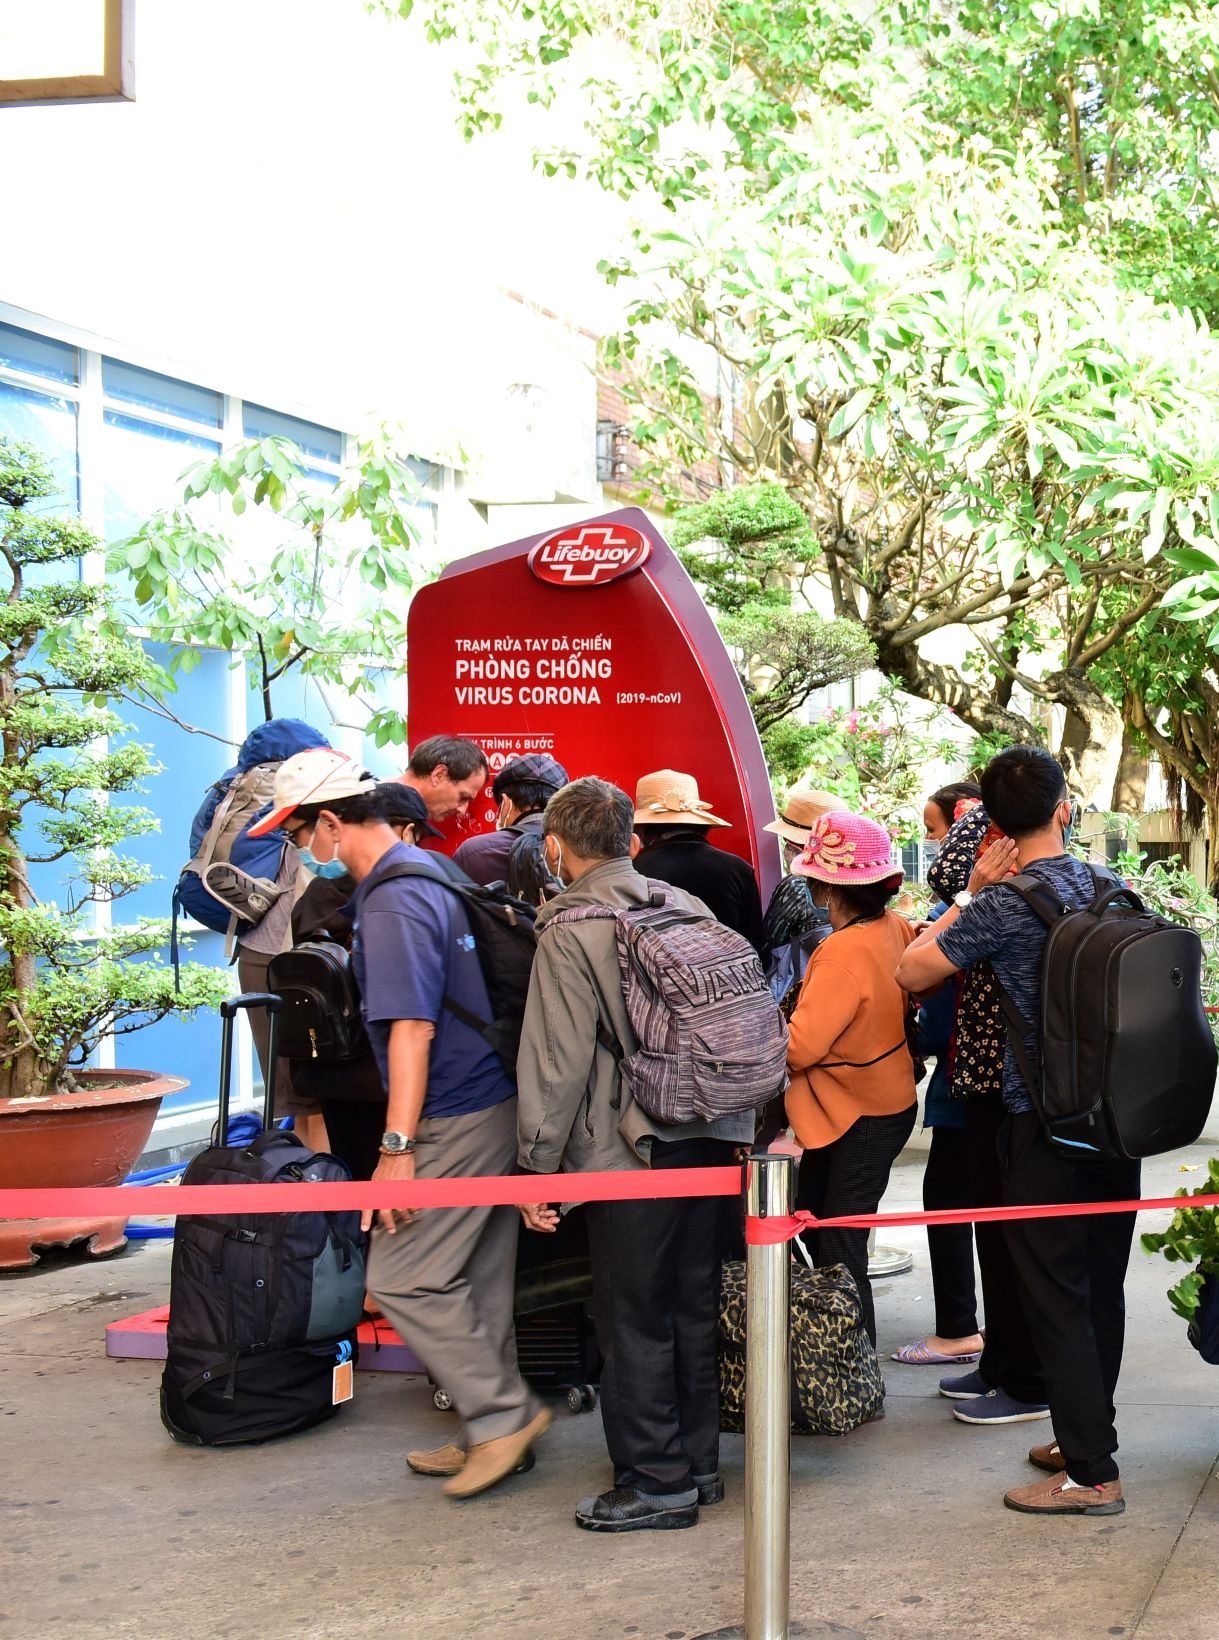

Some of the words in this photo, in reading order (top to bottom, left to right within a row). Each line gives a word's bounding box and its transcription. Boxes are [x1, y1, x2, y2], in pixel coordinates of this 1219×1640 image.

[541, 545, 637, 564] Lifebuoy
[455, 639, 490, 654] TRẠM
[496, 636, 521, 651] RỬA
[525, 639, 548, 650] TAY
[572, 633, 611, 650] CHIẾN
[455, 655, 530, 679] PHÒNG
[536, 653, 611, 679] CHỐNG
[455, 687, 513, 704] VIRUS
[518, 687, 601, 704] CORONA
[616, 693, 681, 704] (2019-nCoV)
[481, 737, 512, 749] TRÌNH
[515, 739, 521, 749] 6
[524, 737, 554, 749] BƯỚC
[663, 958, 769, 1008] VANS
